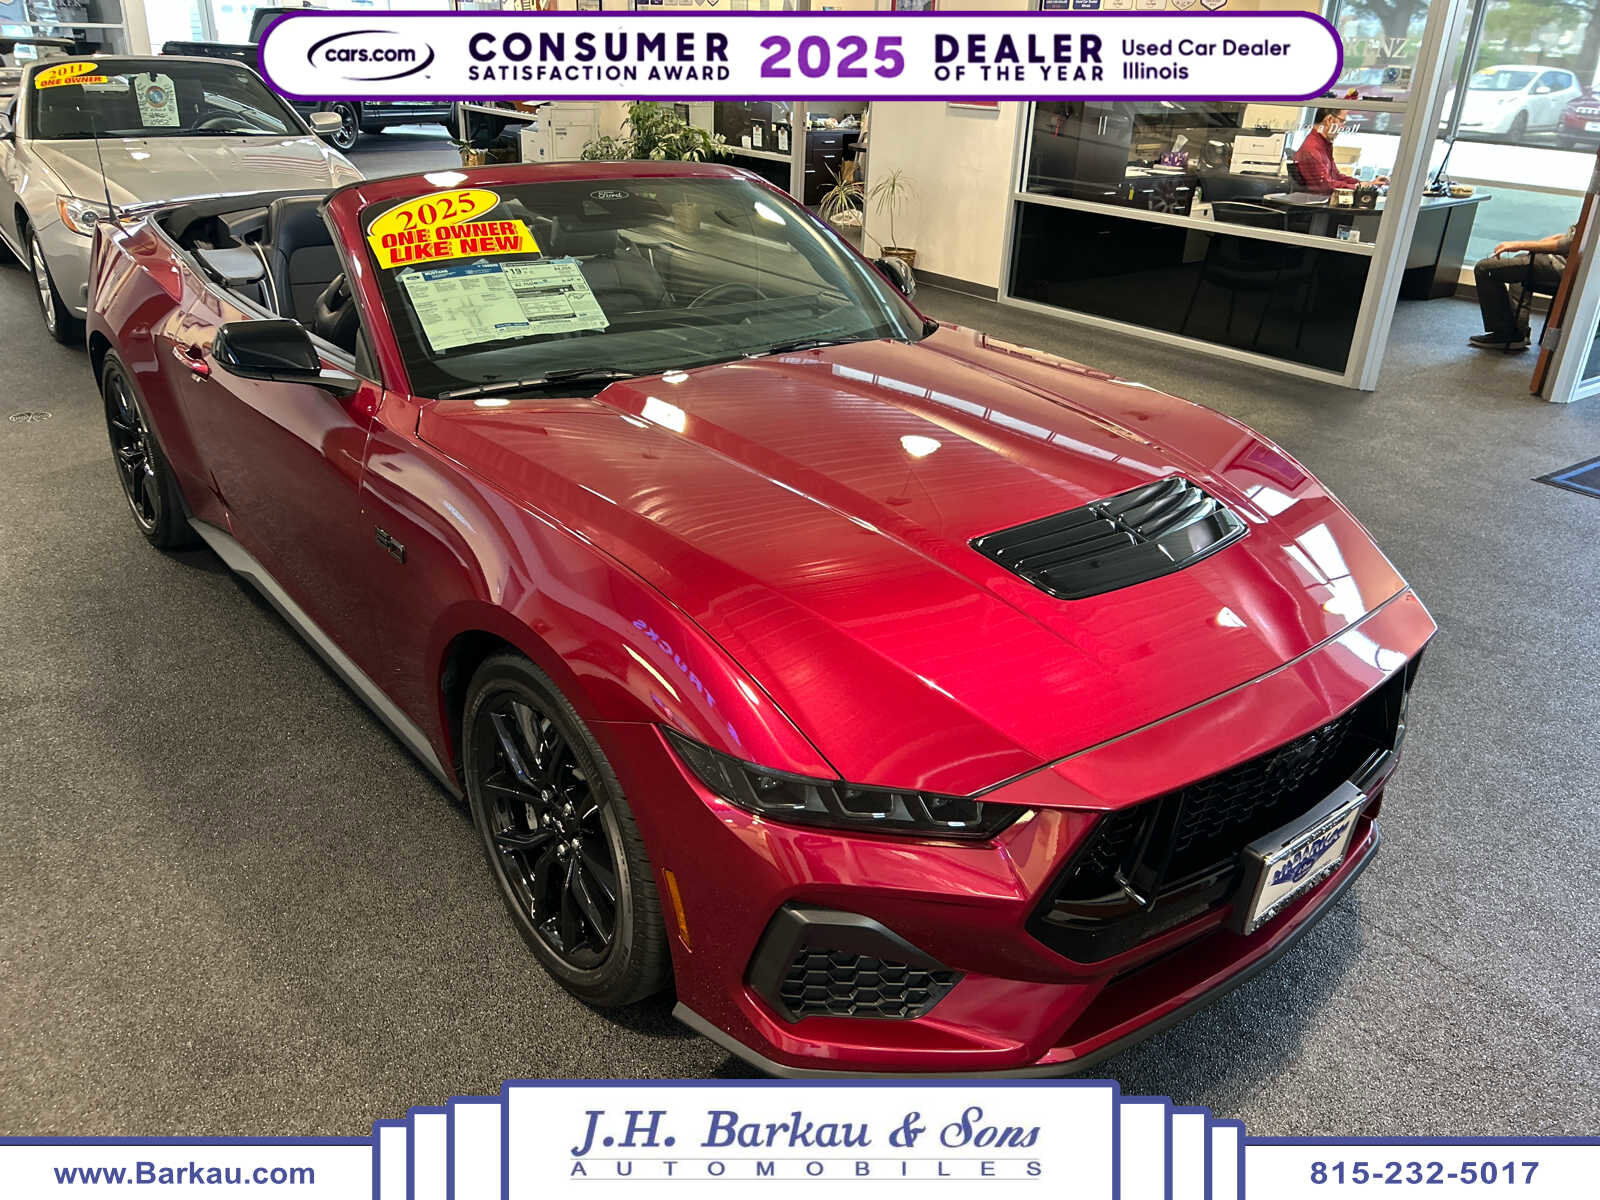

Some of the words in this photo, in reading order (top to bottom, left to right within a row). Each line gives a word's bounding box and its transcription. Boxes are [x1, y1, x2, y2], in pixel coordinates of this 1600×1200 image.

[41, 78, 62, 87] ONE
[64, 76, 103, 84] OWNER
[50, 63, 83, 79] 2011
[395, 192, 476, 231] 2025
[381, 229, 432, 249] ONE
[436, 221, 517, 240] OWNER
[390, 241, 450, 264] LIKE
[460, 236, 524, 254] NEW
